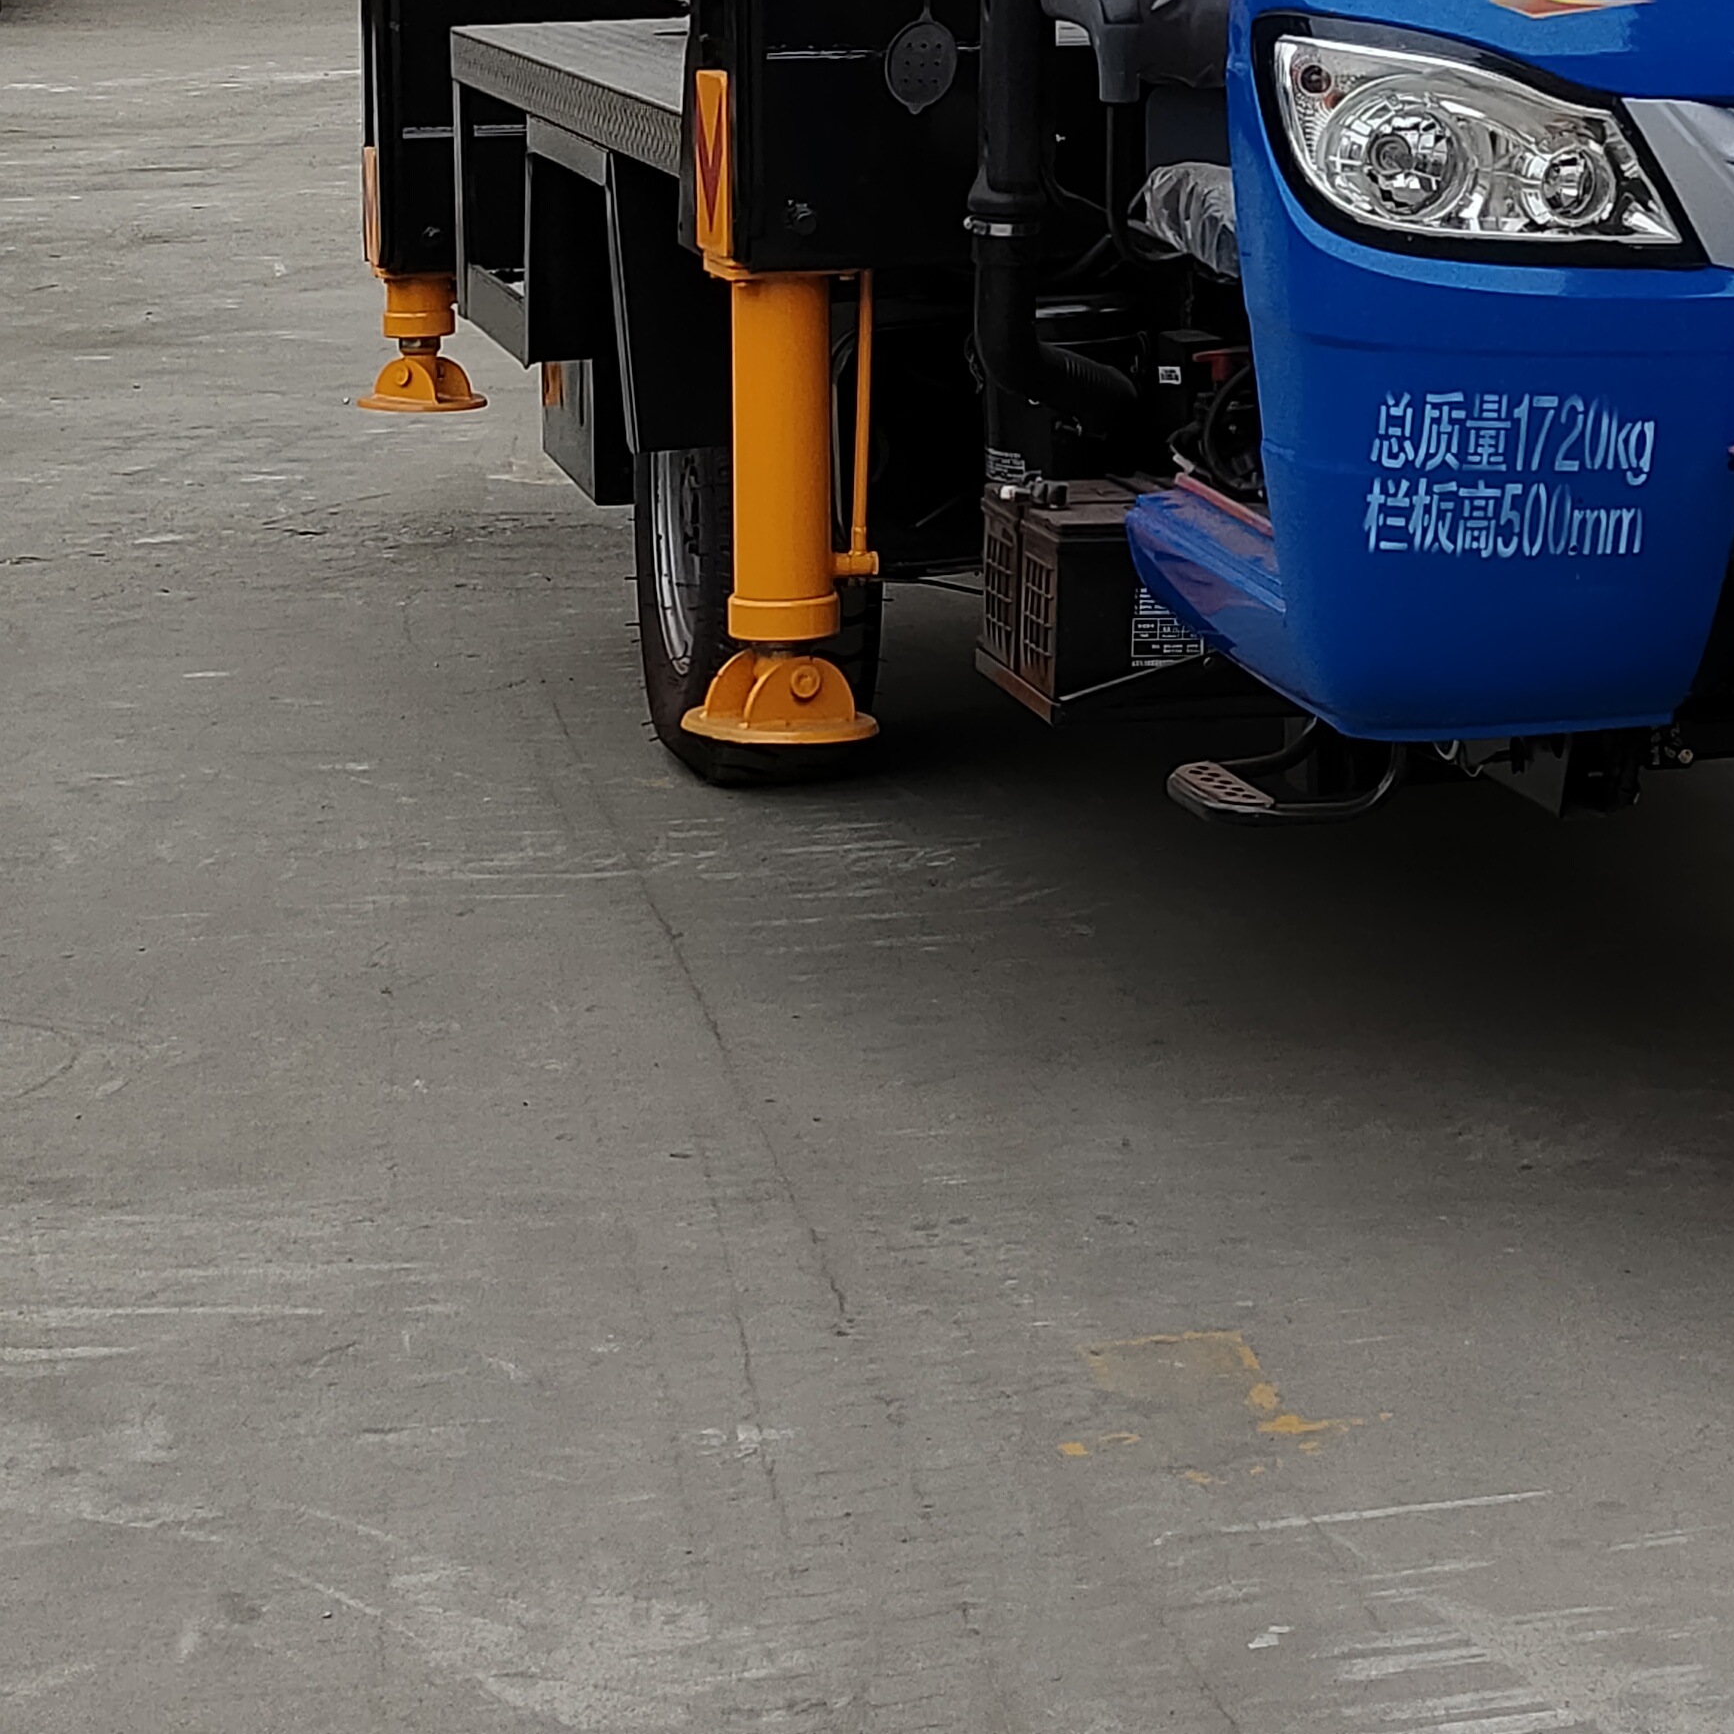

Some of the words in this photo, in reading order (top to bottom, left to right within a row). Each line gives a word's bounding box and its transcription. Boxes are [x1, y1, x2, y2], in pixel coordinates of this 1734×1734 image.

[1370, 391, 1655, 486] 总质量1720kg
[1363, 477, 1643, 558] 栏板高500mm
